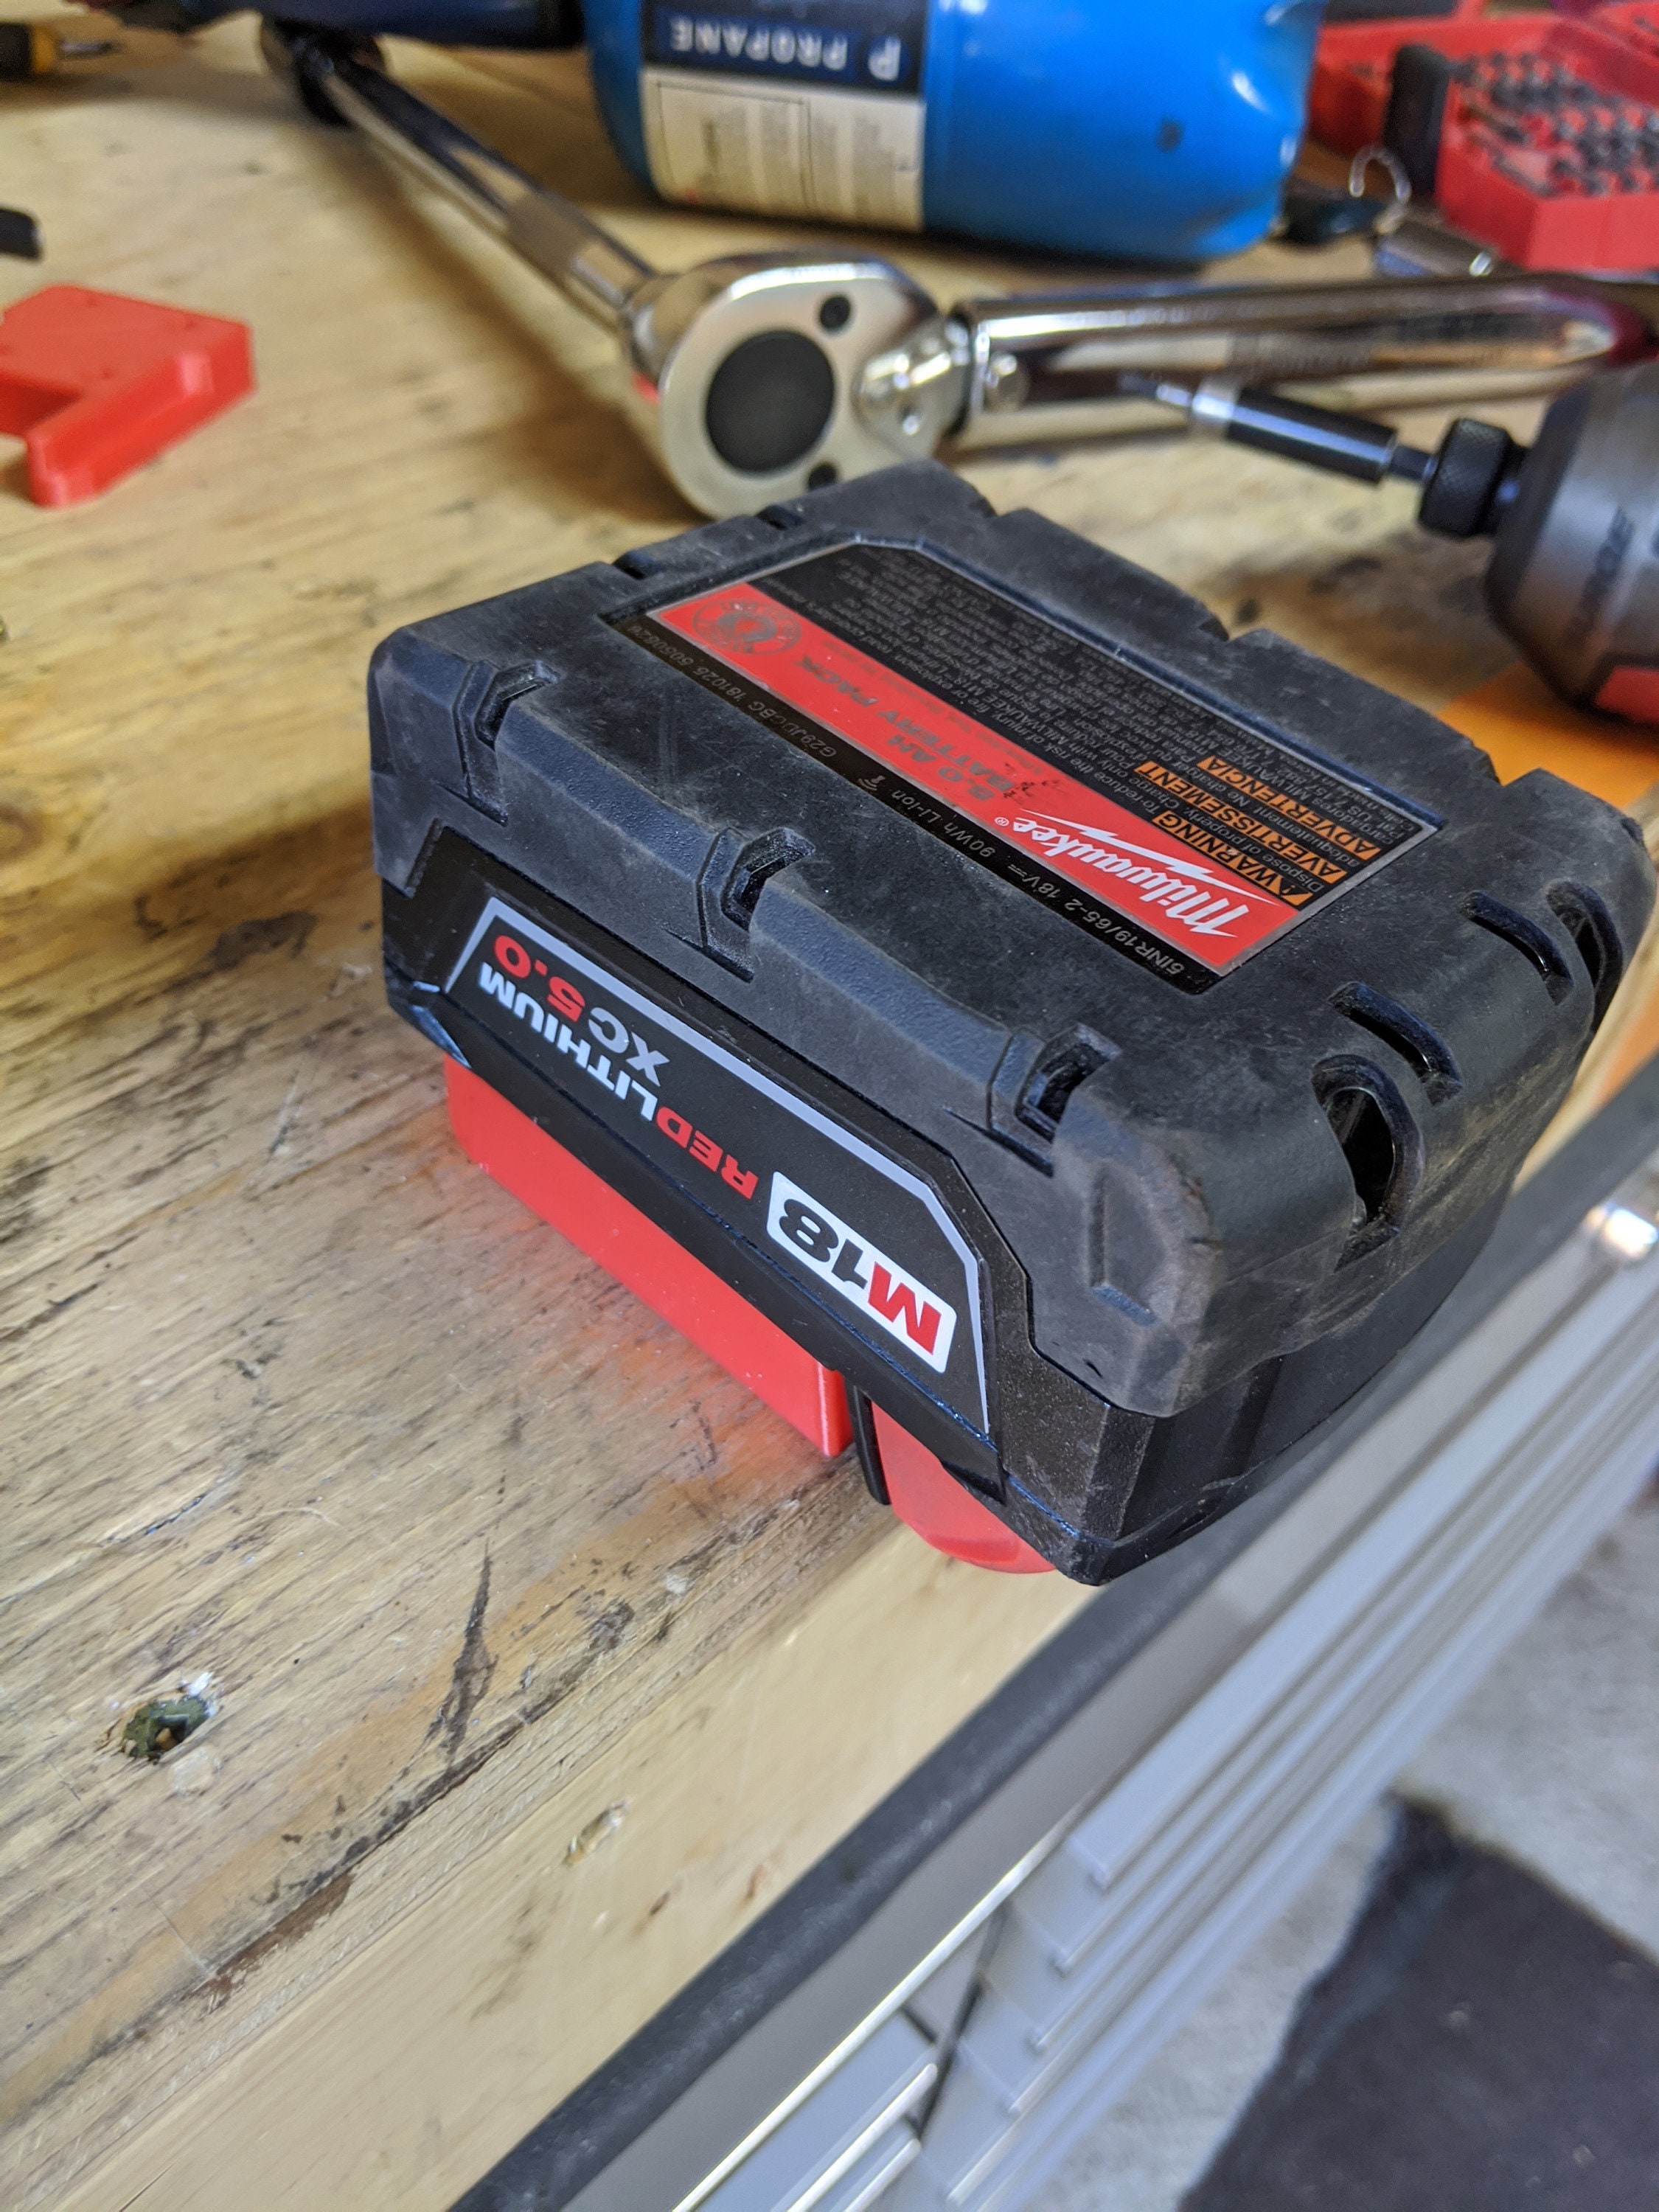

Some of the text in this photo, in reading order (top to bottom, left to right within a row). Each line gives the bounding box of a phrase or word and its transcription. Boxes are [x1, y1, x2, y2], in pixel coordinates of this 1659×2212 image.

[669, 15, 849, 72] PROPANE
[787, 654, 881, 709] PACK
[964, 697, 992, 713] fire
[995, 686, 1044, 714] risque
[981, 693, 1071, 745] MILWAUKEE
[1094, 717, 1123, 733] les
[874, 706, 1018, 793] BATTERY
[1040, 742, 1072, 760] risk
[1065, 741, 1101, 762] with
[1069, 715, 1151, 762] d'explosion
[1116, 728, 1178, 763] qu'avec
[1157, 740, 1197, 762] Para
[882, 733, 998, 802] 5.0 AH
[1065, 757, 1095, 773] the
[1094, 757, 1133, 779] only
[1096, 746, 1135, 769] Pour
[1168, 757, 1231, 793] charger
[1215, 746, 1312, 801] MILWAUKEE
[1089, 771, 1144, 803] reduce
[1124, 774, 1186, 810] Charge
[1223, 790, 1252, 807] Ne
[1136, 763, 1343, 880] AVERTISSEMENT
[1138, 799, 1163, 814] To
[1200, 757, 1377, 857] ADVERTENCIA
[1307, 795, 1397, 846] cargadores
[1344, 804, 1374, 821] US
[940, 821, 1000, 858] 90Wh
[1178, 804, 1248, 846] properly.
[1155, 812, 1282, 887] WARNING
[1239, 841, 1263, 856] of
[1258, 850, 1328, 893] Dispose
[480, 961, 942, 1355] M18 REDLITHIUM
